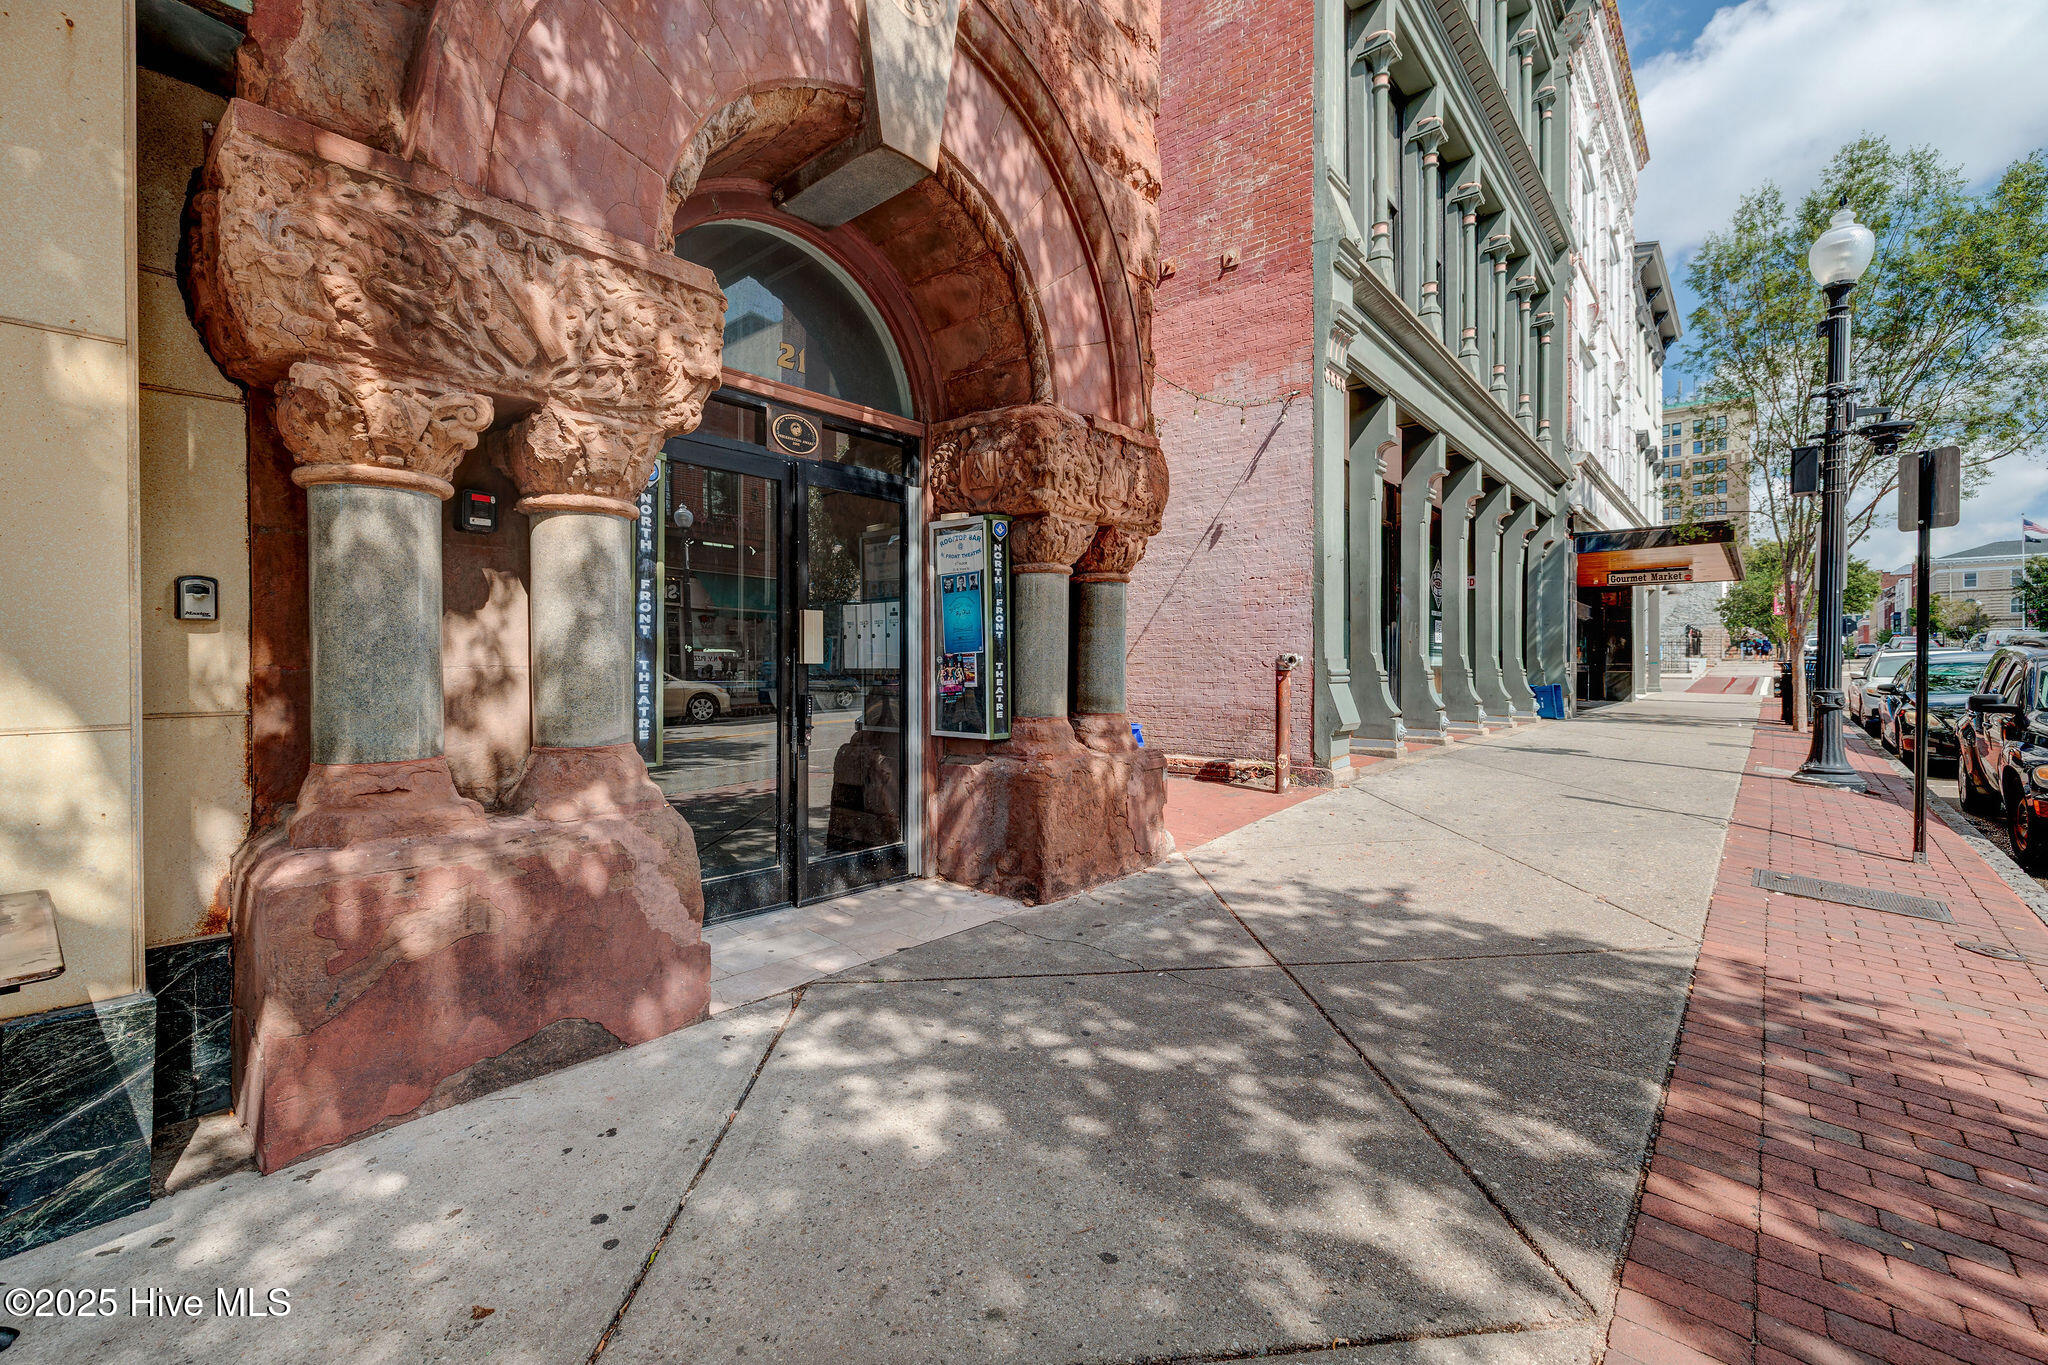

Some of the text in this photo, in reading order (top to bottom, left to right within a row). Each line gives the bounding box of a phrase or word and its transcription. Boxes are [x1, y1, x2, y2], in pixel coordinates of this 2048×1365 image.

[777, 342, 806, 374] 21
[968, 534, 981, 542] BAR
[1610, 574, 1647, 583] Gourmet
[1651, 572, 1682, 580] Market
[637, 493, 652, 739] NORTH FRONT THEATRE
[994, 544, 1004, 718] NORTH FRONT THEATRE
